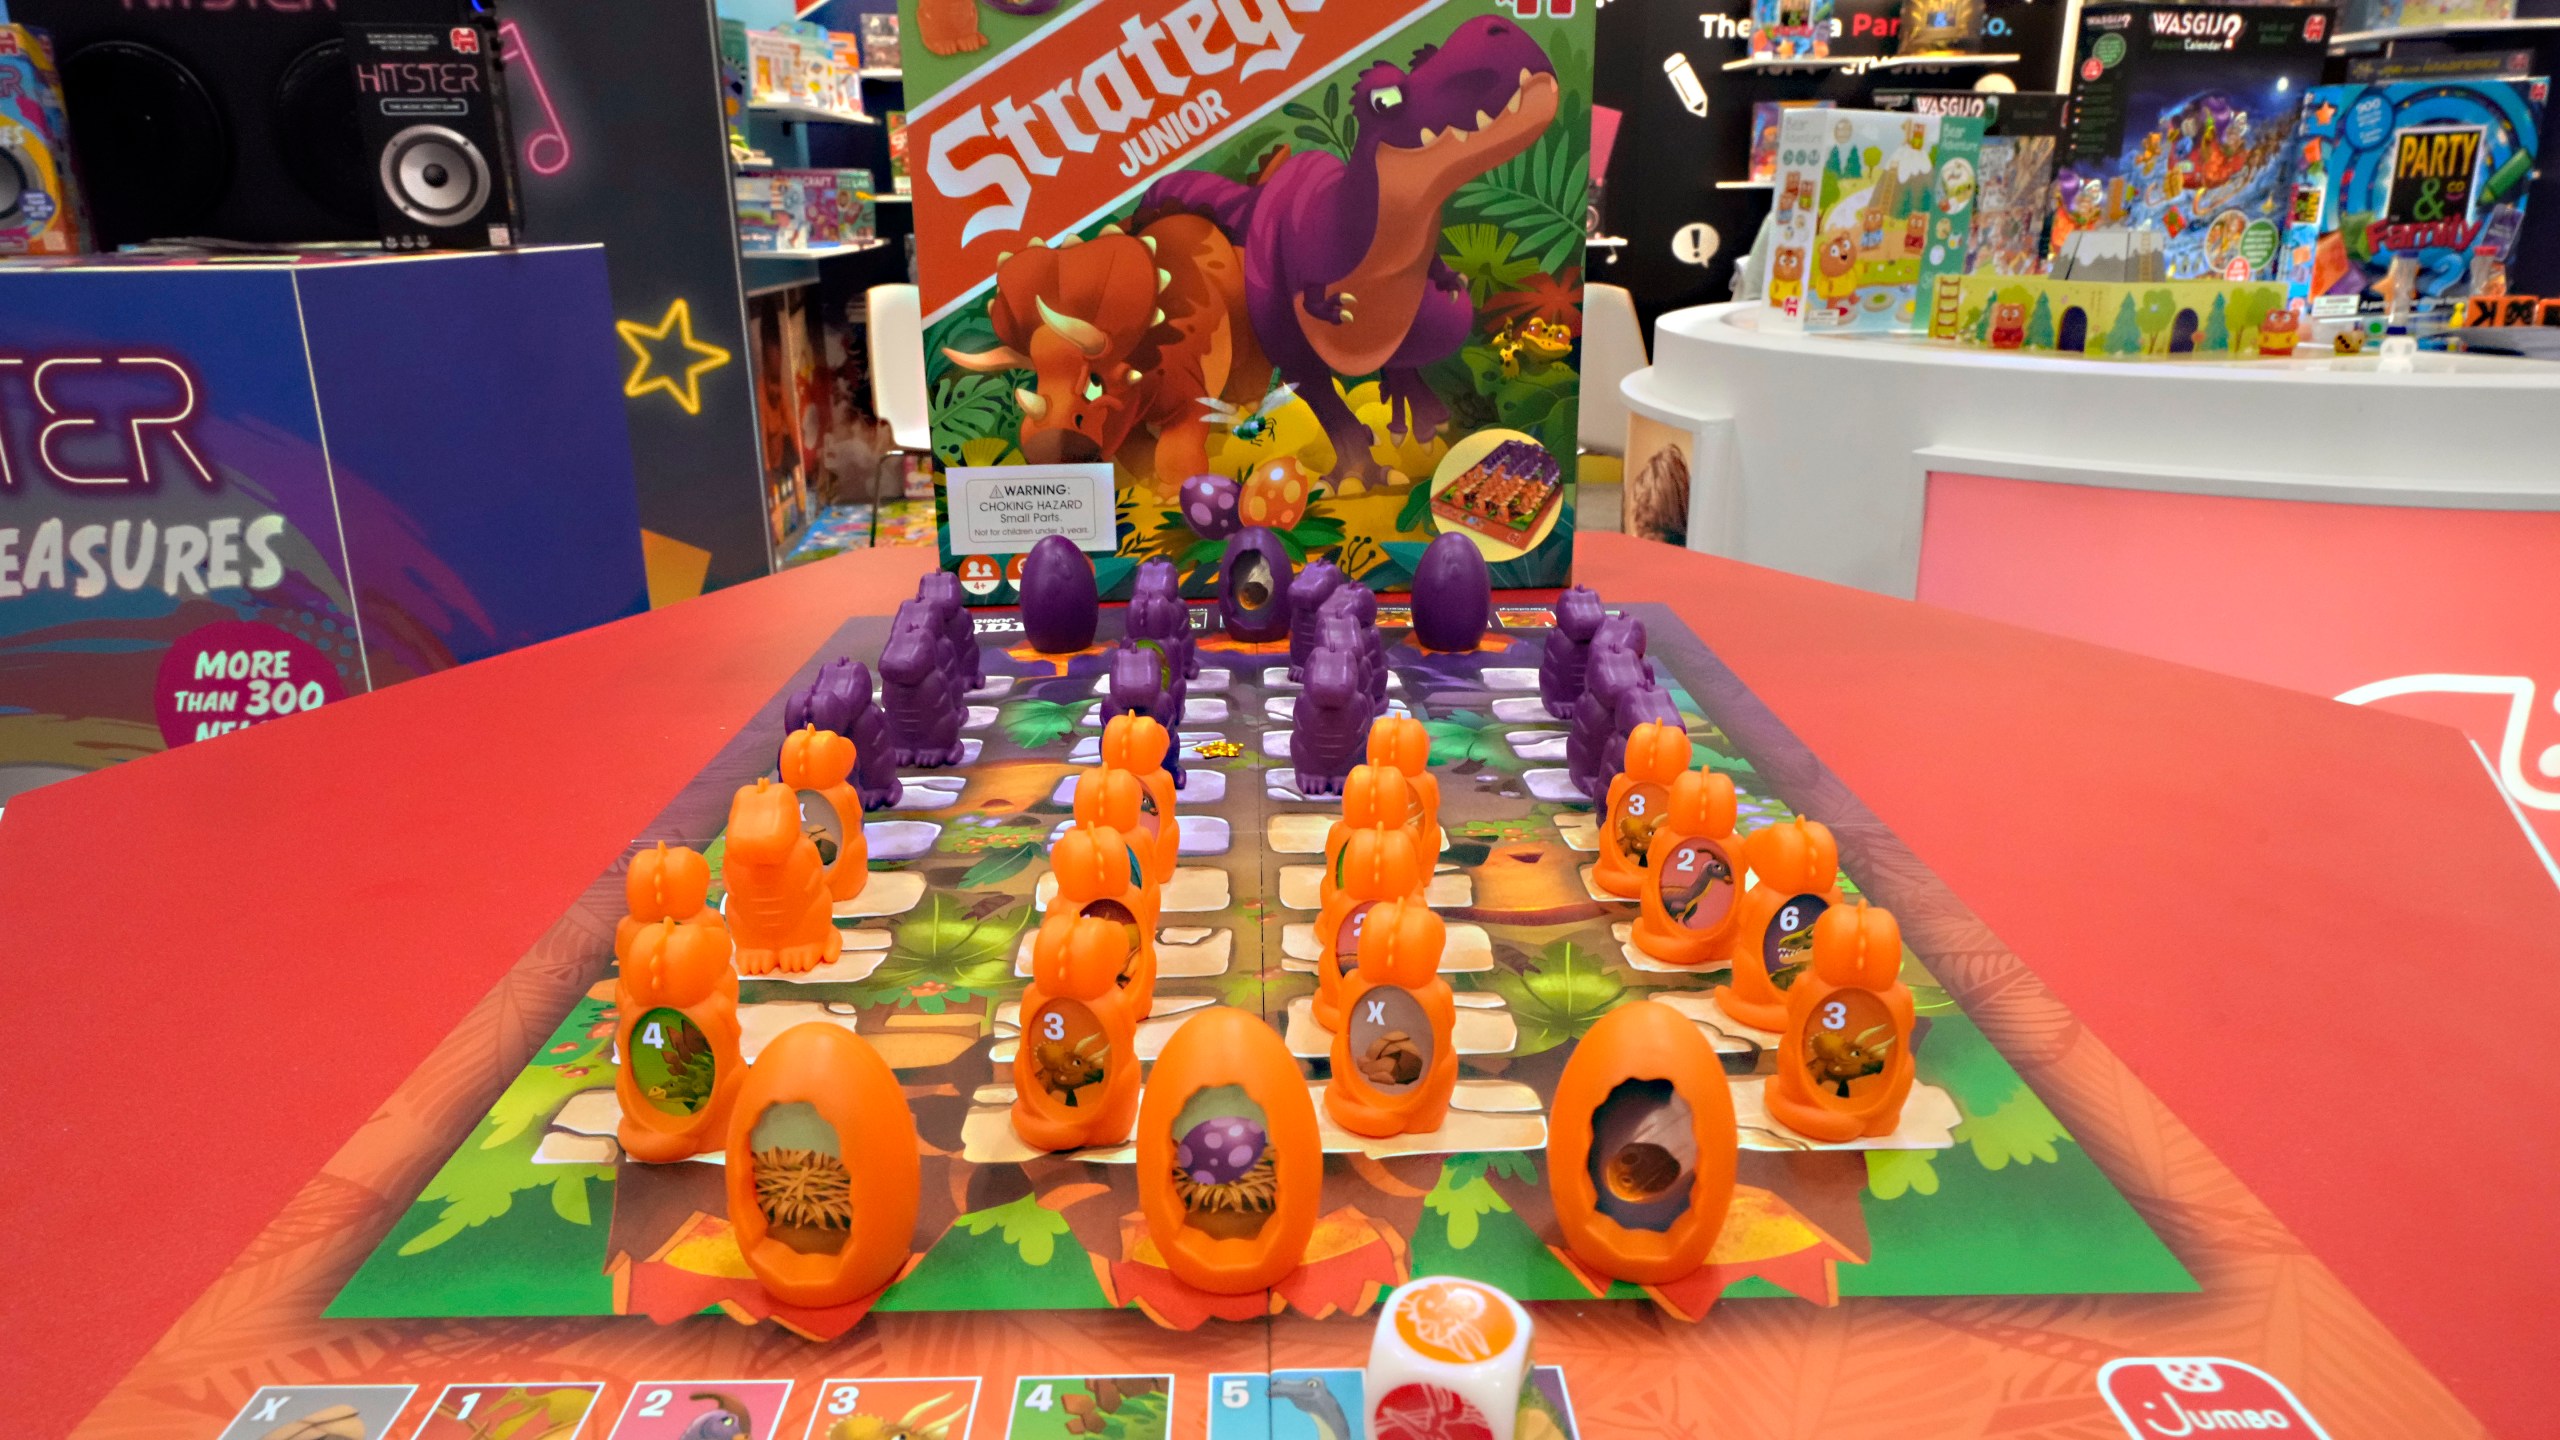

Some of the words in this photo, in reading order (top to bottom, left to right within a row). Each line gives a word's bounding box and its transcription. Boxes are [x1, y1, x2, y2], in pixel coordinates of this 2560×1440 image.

[1700, 14, 1750, 39] The
[1853, 14, 1902, 38] Par
[2152, 11, 2243, 49] WASGIJ?
[2184, 38, 2222, 50] Calendar
[357, 63, 481, 92] HITSTER
[926, 0, 1326, 249] Strateg
[1118, 88, 1231, 179] JUNIOR
[1942, 124, 1967, 138] Bear
[2399, 132, 2480, 179] PARTY
[2413, 177, 2445, 221] &
[2366, 213, 2482, 254] Family
[1004, 484, 1071, 496] WARNING:
[979, 501, 1034, 512] CHOKING
[1037, 500, 1083, 510] HAZARD
[1000, 513, 1030, 524] Small
[1033, 513, 1063, 523] Parts.
[989, 528, 1001, 536] for
[1002, 527, 1034, 536] children
[1035, 527, 1058, 535] under
[1066, 527, 1089, 536] years.
[973, 582, 986, 590] 4+
[194, 650, 291, 680] MORE
[175, 690, 238, 712] THAN
[245, 679, 325, 716] 300
[1628, 793, 1646, 816] 3
[1677, 848, 1695, 872] 2
[1780, 906, 1798, 931] 6
[1042, 1012, 1066, 1041] 3
[1366, 1000, 1386, 1026] X
[1822, 1002, 1846, 1030] 3
[641, 1022, 665, 1050] 4
[456, 1393, 483, 1420] 1
[639, 1390, 674, 1417] 2
[828, 1387, 859, 1415] 3
[1024, 1383, 1054, 1412] 4
[1222, 1380, 1250, 1409] 5
[250, 1396, 290, 1422] X
